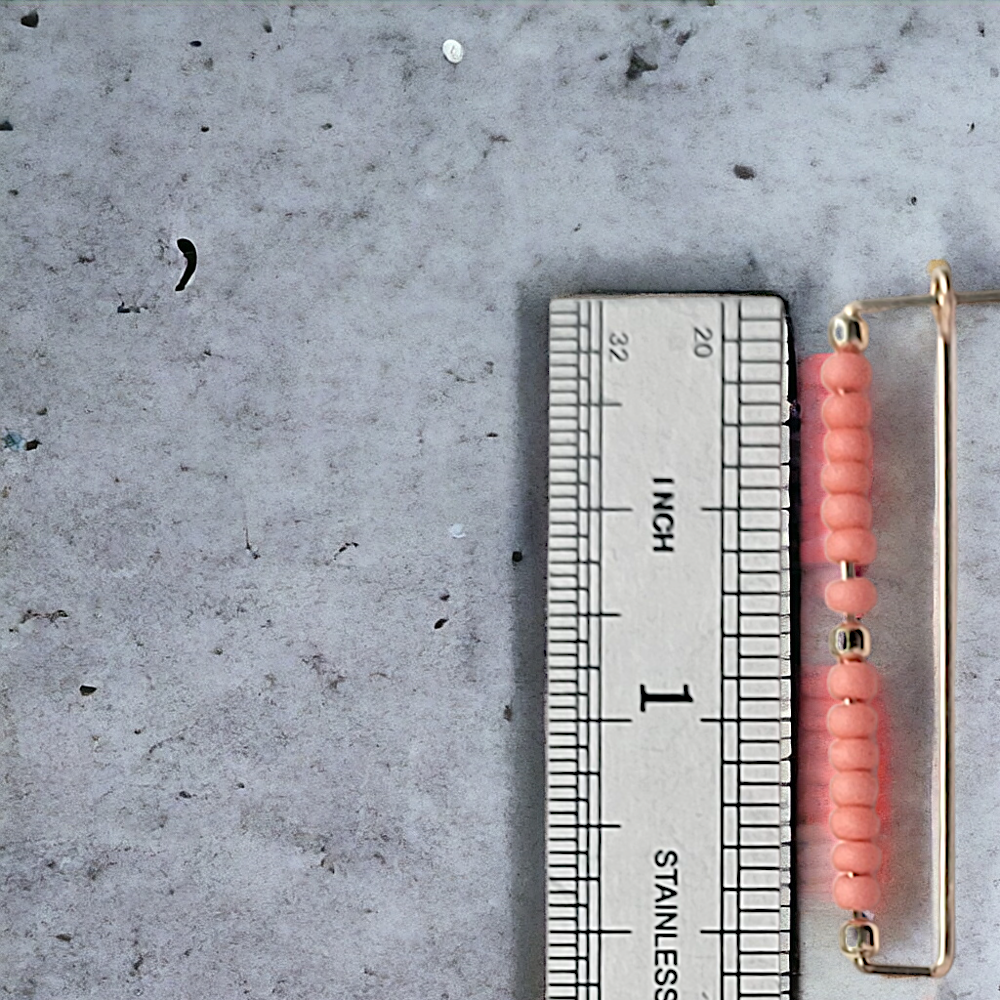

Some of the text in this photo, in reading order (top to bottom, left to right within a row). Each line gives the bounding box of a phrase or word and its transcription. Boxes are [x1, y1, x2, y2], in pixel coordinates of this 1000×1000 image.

[608, 333, 629, 362] 32
[692, 326, 714, 359] 20
[652, 477, 675, 553] INCH
[639, 683, 694, 713] 1
